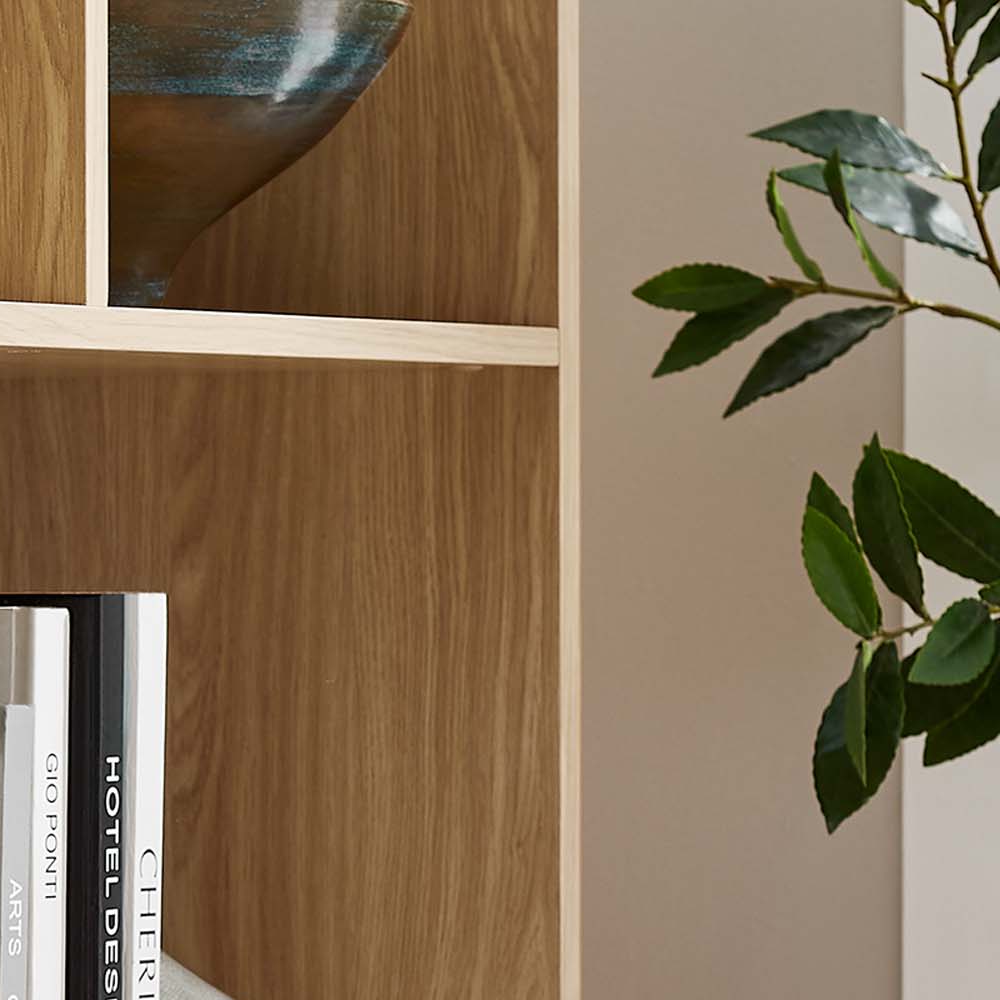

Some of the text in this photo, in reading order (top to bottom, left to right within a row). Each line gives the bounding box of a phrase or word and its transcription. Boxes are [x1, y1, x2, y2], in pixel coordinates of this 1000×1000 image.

[44, 753, 59, 899] GIO PONTI
[105, 755, 121, 899] HOTEL
[8, 878, 23, 957] ARTS
